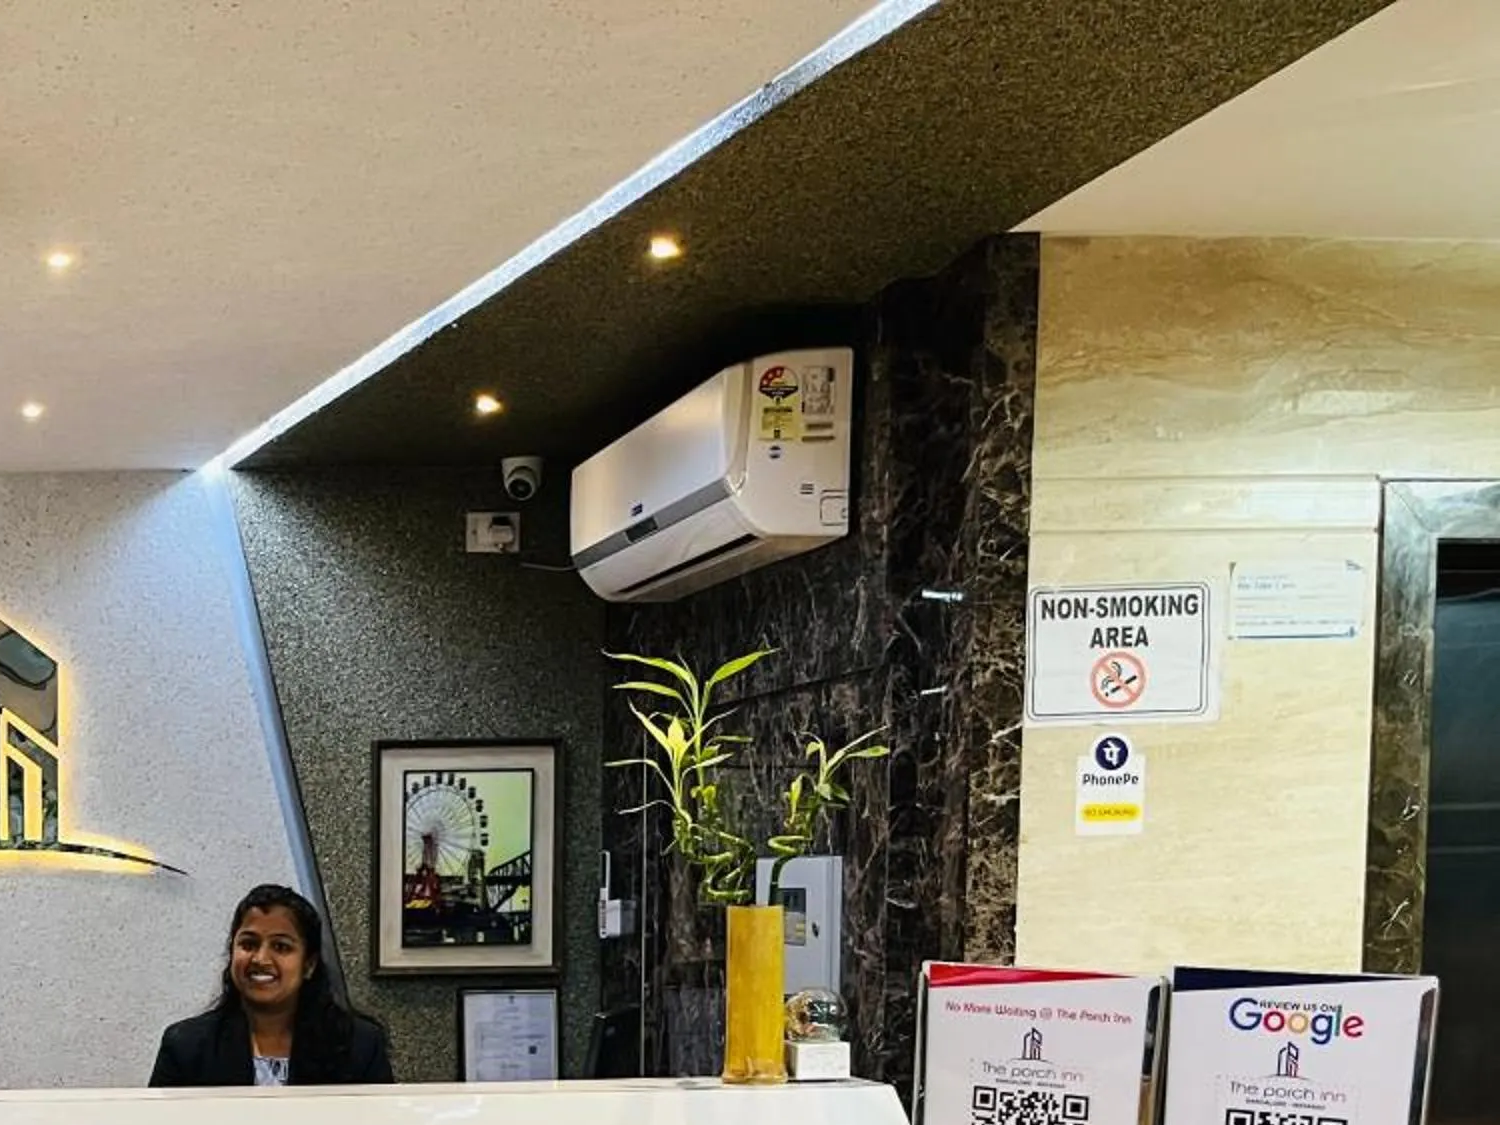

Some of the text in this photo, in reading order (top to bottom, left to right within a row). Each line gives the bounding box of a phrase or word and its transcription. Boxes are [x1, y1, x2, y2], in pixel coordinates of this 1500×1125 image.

[1041, 594, 1199, 620] NON-SMOKING
[1089, 626, 1149, 649] AREA
[1082, 773, 1139, 785] PhonePe
[946, 1001, 961, 1011] No
[964, 1003, 991, 1013] More
[995, 1004, 1037, 1019] Waiting
[1057, 1008, 1076, 1020] The
[1080, 1010, 1111, 1023] Porch
[1259, 1000, 1337, 1013] REVIEW US ON
[1229, 998, 1364, 1045] Google
[982, 1061, 1007, 1074] The
[1011, 1066, 1056, 1080] porch
[1230, 1081, 1347, 1104] The porch inn
